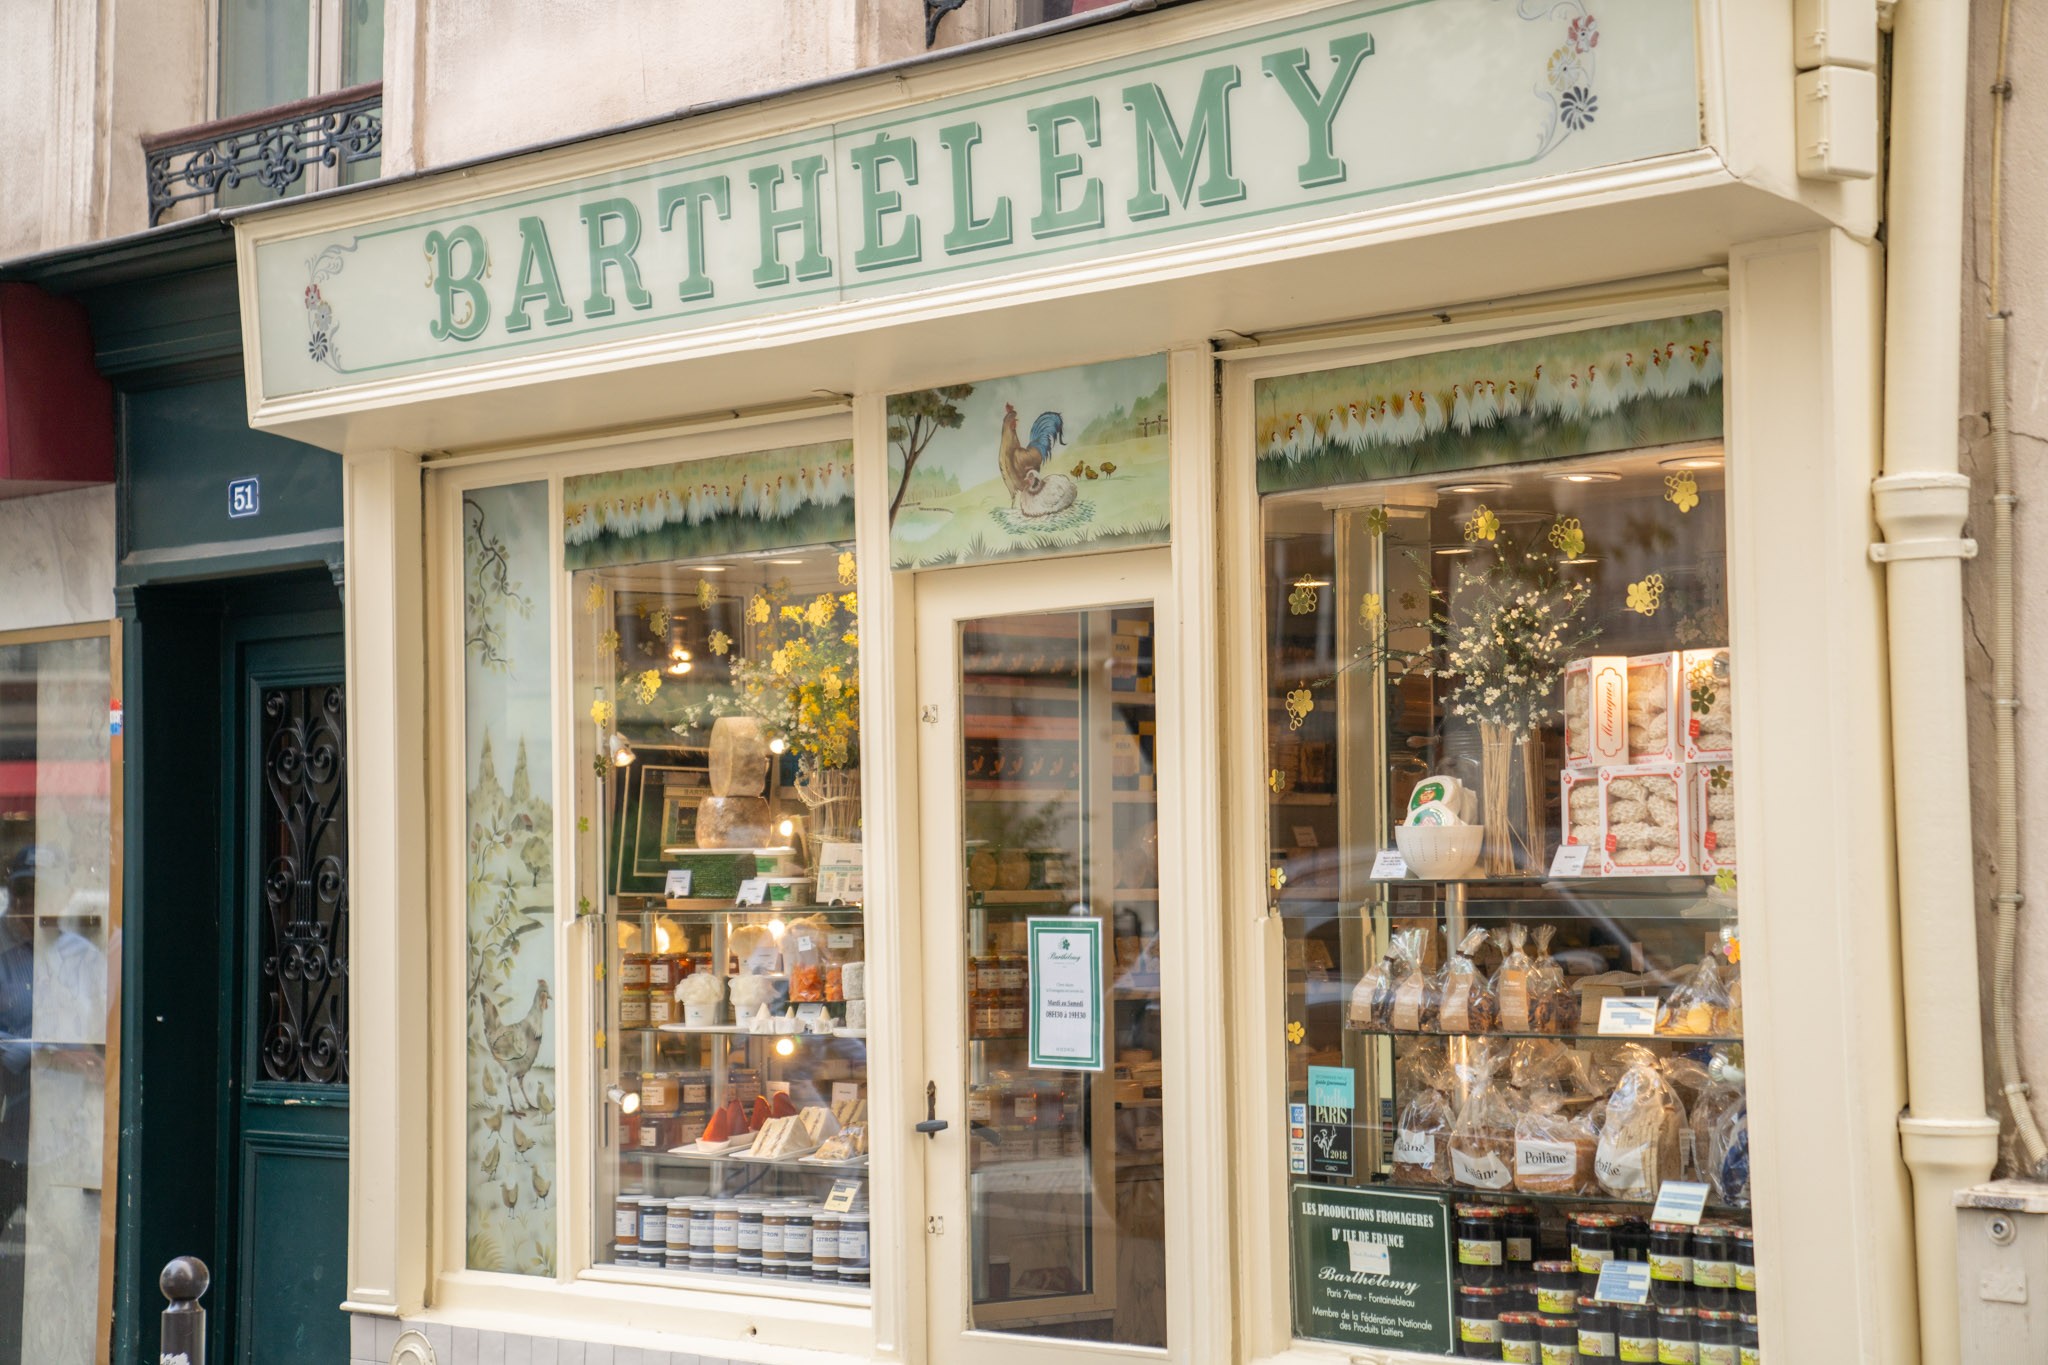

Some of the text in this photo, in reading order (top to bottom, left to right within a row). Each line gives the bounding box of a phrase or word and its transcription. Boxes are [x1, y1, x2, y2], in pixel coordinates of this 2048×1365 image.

[234, 484, 253, 511] 51
[1315, 1105, 1347, 1125] PARIS
[1330, 1149, 1347, 1160] 2018
[1525, 1151, 1567, 1165] Poilâne
[1302, 1202, 1434, 1228] LES PRODUCTIONS FROMAGERES
[1331, 1228, 1404, 1248] D' ILE DE FRANCE
[1326, 1287, 1342, 1299] Paris
[1368, 1293, 1415, 1308] Fontainebleau
[1312, 1306, 1433, 1331] Membre de la Fédération Nationale
[1339, 1320, 1404, 1338] des Produits Laitiers
